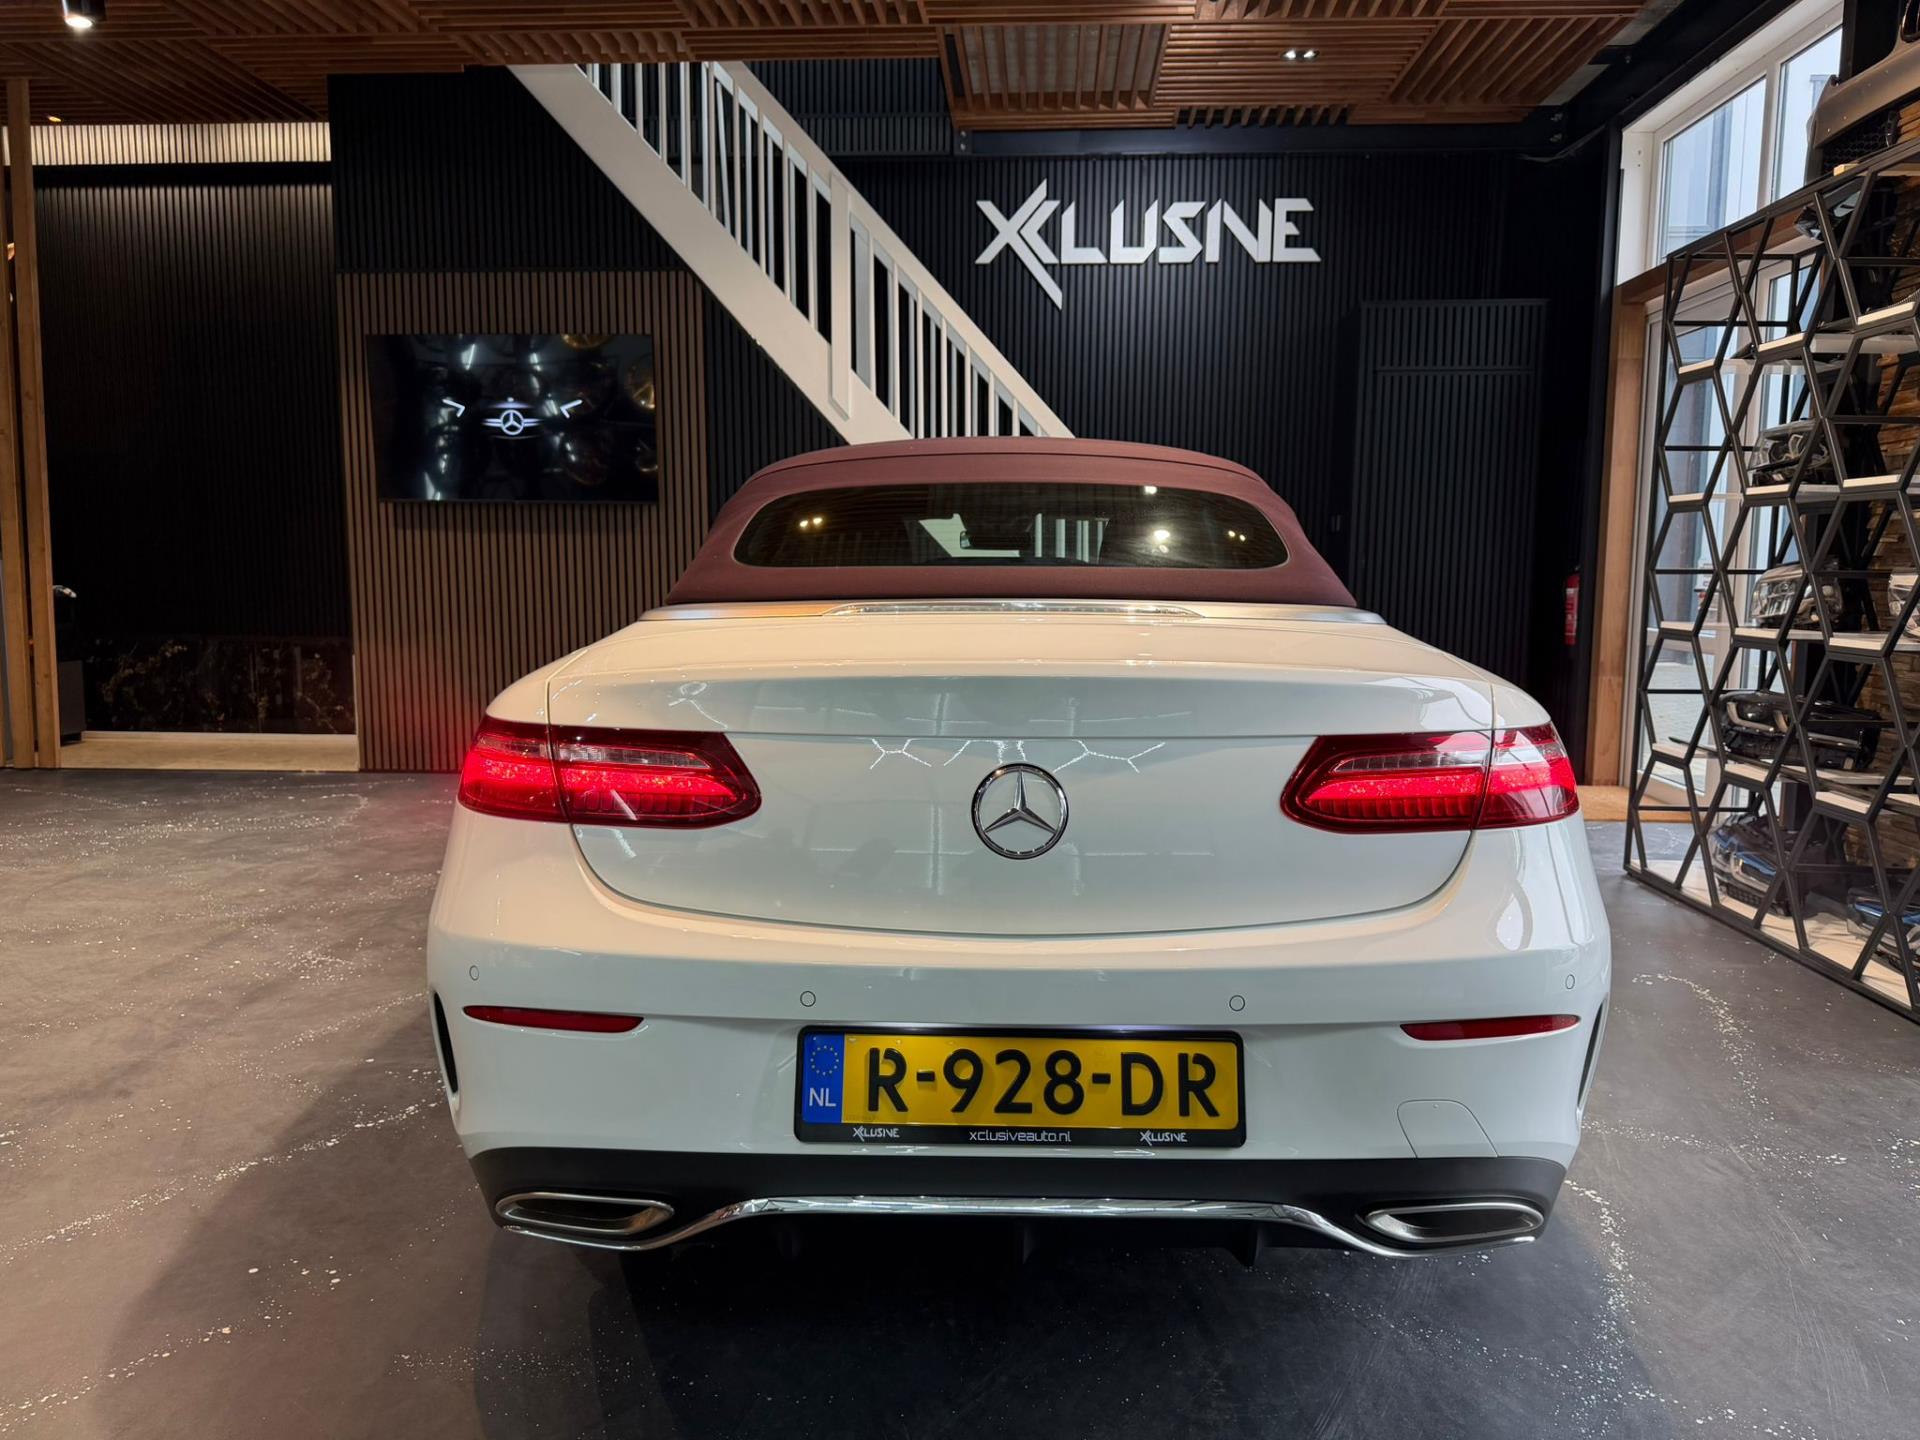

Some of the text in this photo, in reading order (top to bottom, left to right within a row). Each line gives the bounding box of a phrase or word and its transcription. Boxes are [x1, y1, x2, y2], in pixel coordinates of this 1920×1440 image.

[867, 1047, 1219, 1117] R-928-DR
[809, 1087, 836, 1107] NL
[969, 1130, 1072, 1142] xclusiveauto.nl
